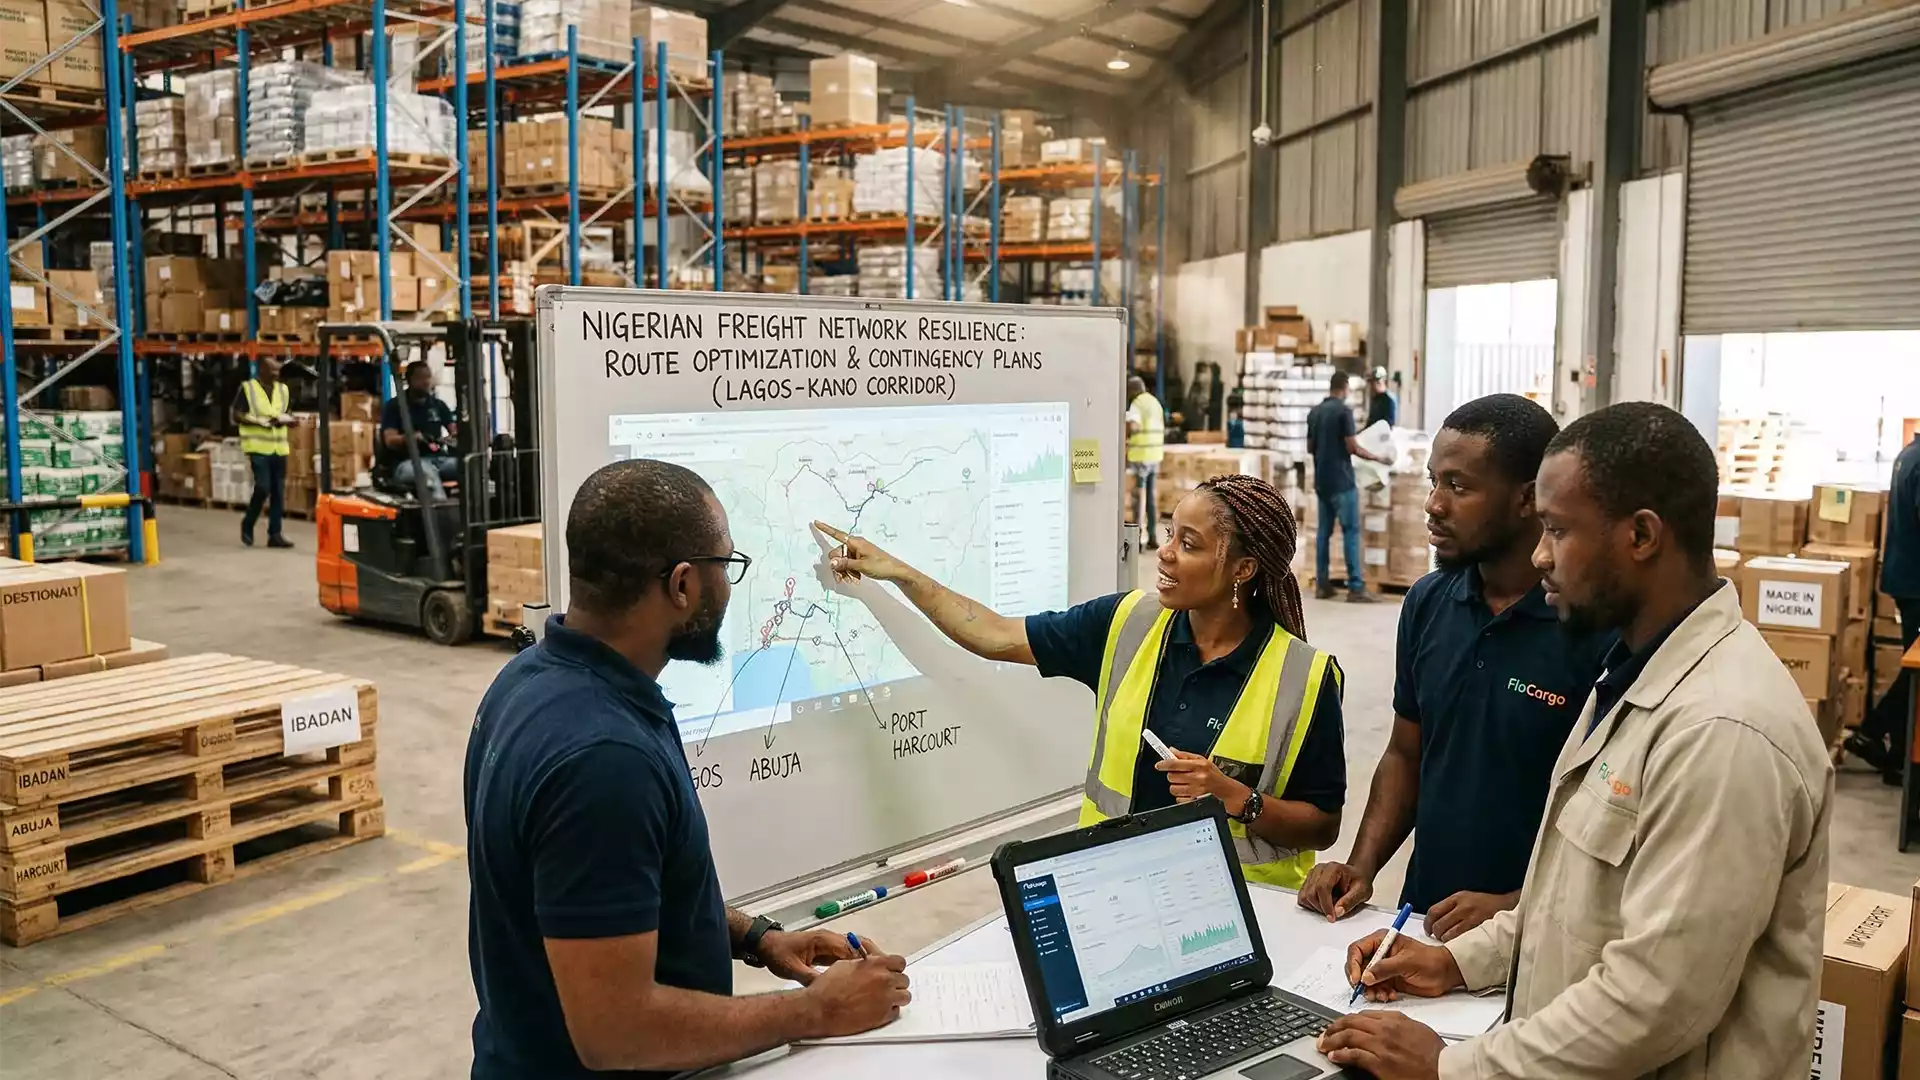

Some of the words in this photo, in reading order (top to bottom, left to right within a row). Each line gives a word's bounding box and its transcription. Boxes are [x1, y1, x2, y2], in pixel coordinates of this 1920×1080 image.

[582, 310, 703, 342] NIGERIAN
[718, 312, 808, 341] FREIGHT
[819, 316, 908, 341] NETWORK
[918, 316, 1026, 342] RESILIENCE:
[605, 349, 680, 378] ROUTE
[693, 348, 837, 373] OPTIMIZATION
[847, 345, 861, 370] &
[868, 348, 984, 369] CONTINGENCY
[993, 348, 1043, 370] PLANS
[712, 375, 857, 408] (LAGOS-KANO
[866, 372, 956, 401] CORRIDOR)
[1766, 589, 1800, 601] MADE
[1803, 592, 1815, 602] IN
[1766, 604, 1814, 616] NIGERIA
[1507, 678, 1566, 706] FloCargo
[291, 705, 353, 733] IBADAN
[891, 709, 928, 735] PORT
[892, 725, 962, 760] HARCOURT
[18, 766, 66, 789] IBADAN
[690, 763, 723, 790] GOS
[749, 751, 802, 782] ABUJA
[11, 817, 54, 838] ABUJA
[15, 858, 66, 883] HARCOURT
